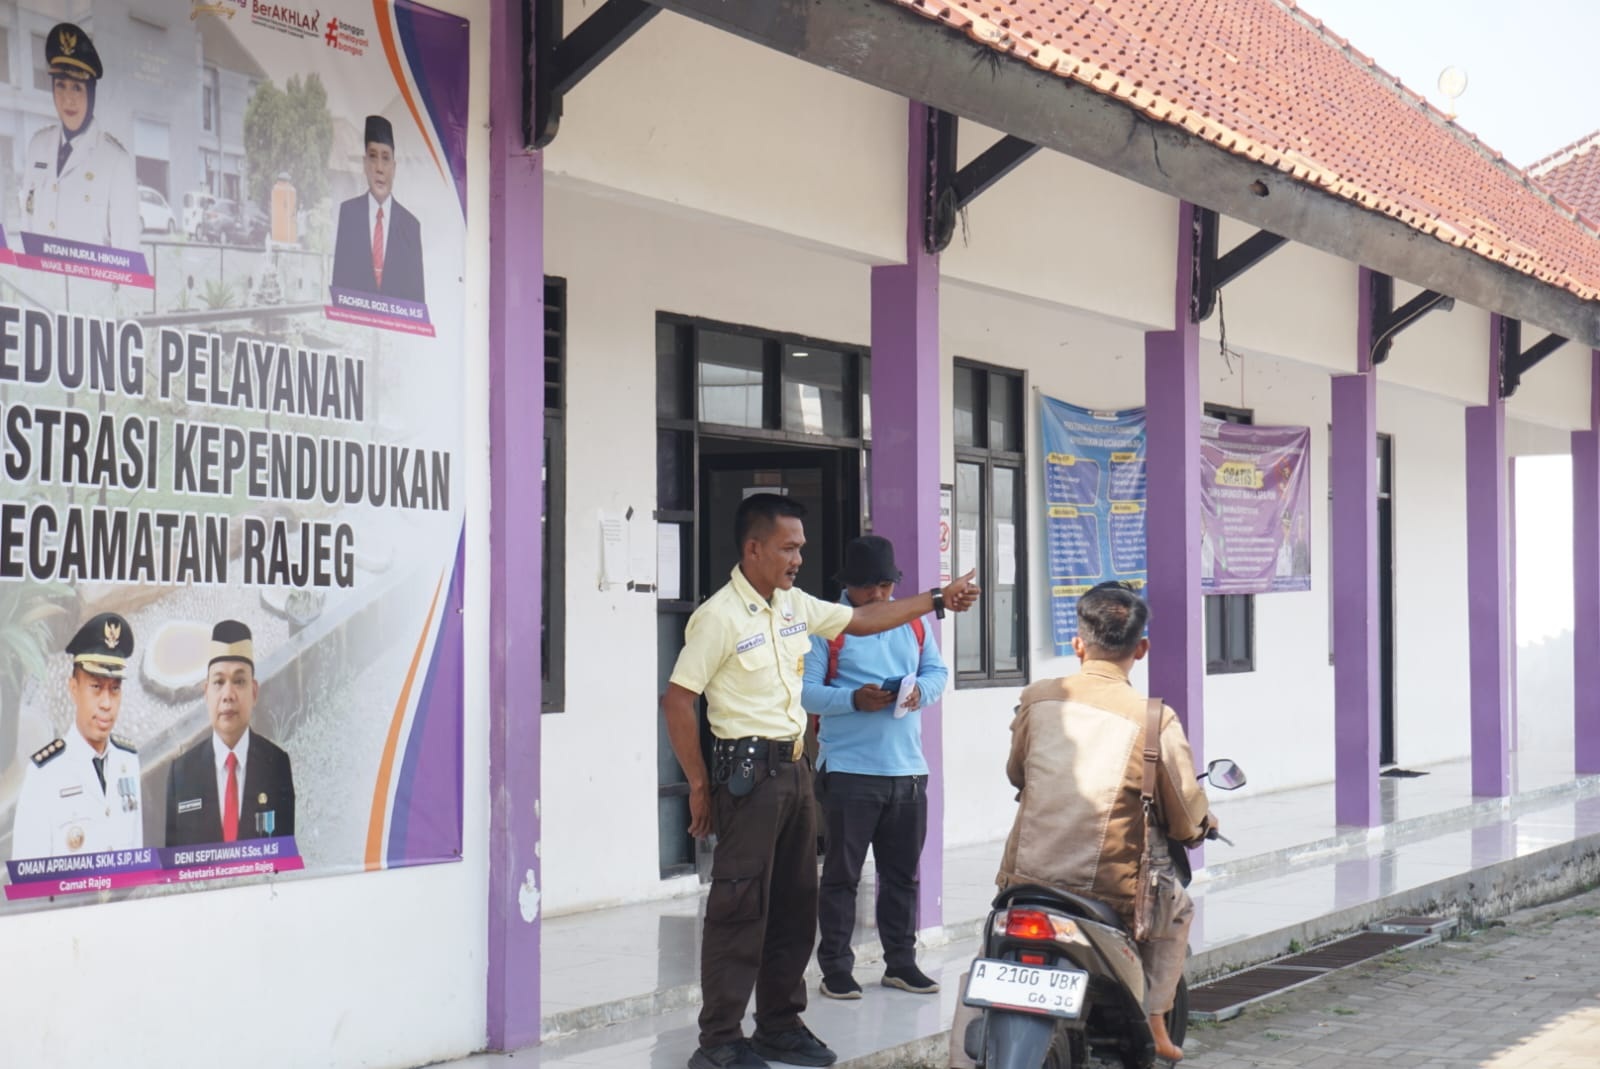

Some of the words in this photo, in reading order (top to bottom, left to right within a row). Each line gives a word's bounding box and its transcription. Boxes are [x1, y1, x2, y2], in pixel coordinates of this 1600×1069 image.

[252, 0, 320, 32] BerAKHLAK
[43, 243, 69, 256] INTAN
[70, 248, 96, 261] NURUL
[99, 252, 130, 267] HIKMAH
[41, 260, 64, 272] WAKIL
[65, 264, 90, 276] BUPATI
[91, 268, 133, 282] TANGERANG
[0, 306, 144, 393] EDUNG
[161, 330, 364, 421] PELAYANAN
[0, 404, 158, 489] STRASI
[174, 423, 450, 511] KEPENDUDUKAN
[0, 504, 228, 584] ECAMATAN
[244, 518, 354, 588] RAJEG
[18, 861, 45, 875] OMAN
[46, 857, 94, 874] APRIAMAN,
[95, 854, 116, 869] SKM,
[135, 849, 151, 863] M.Si
[174, 851, 194, 865] DENI
[195, 847, 241, 862] SEPTIAWAN
[263, 842, 279, 855] M.Si
[178, 867, 215, 880] Sekretaris
[215, 864, 254, 877] Kecamatan
[254, 861, 274, 873] Rajeg
[59, 879, 87, 891] Camat
[88, 877, 111, 889] Rajeg
[976, 963, 986, 979] A
[996, 966, 1040, 986] 2100
[1049, 972, 1080, 991] VBK
